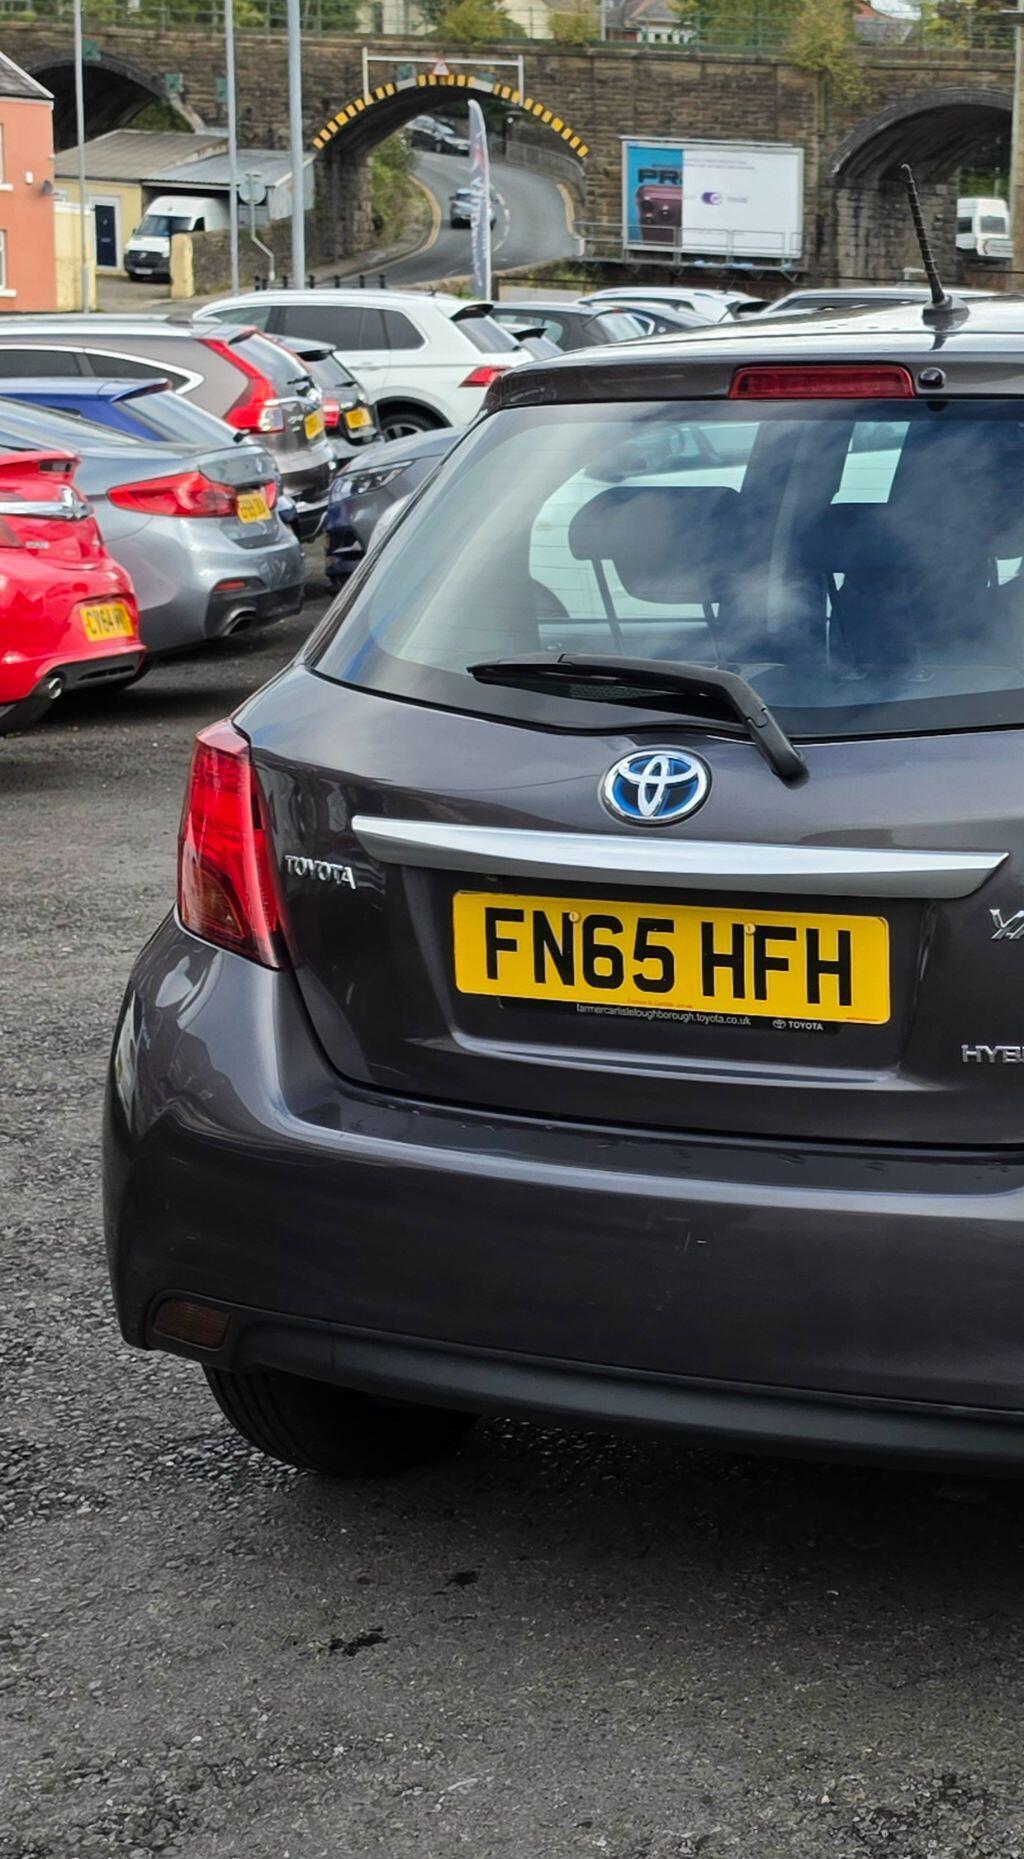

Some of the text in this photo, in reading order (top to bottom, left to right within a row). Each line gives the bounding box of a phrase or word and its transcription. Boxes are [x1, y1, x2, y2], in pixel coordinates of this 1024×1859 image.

[637, 168, 683, 186] PR
[284, 854, 357, 890] TOYOTA
[485, 906, 852, 1007] FN65 HFH
[788, 1020, 824, 1031] TOYOTA
